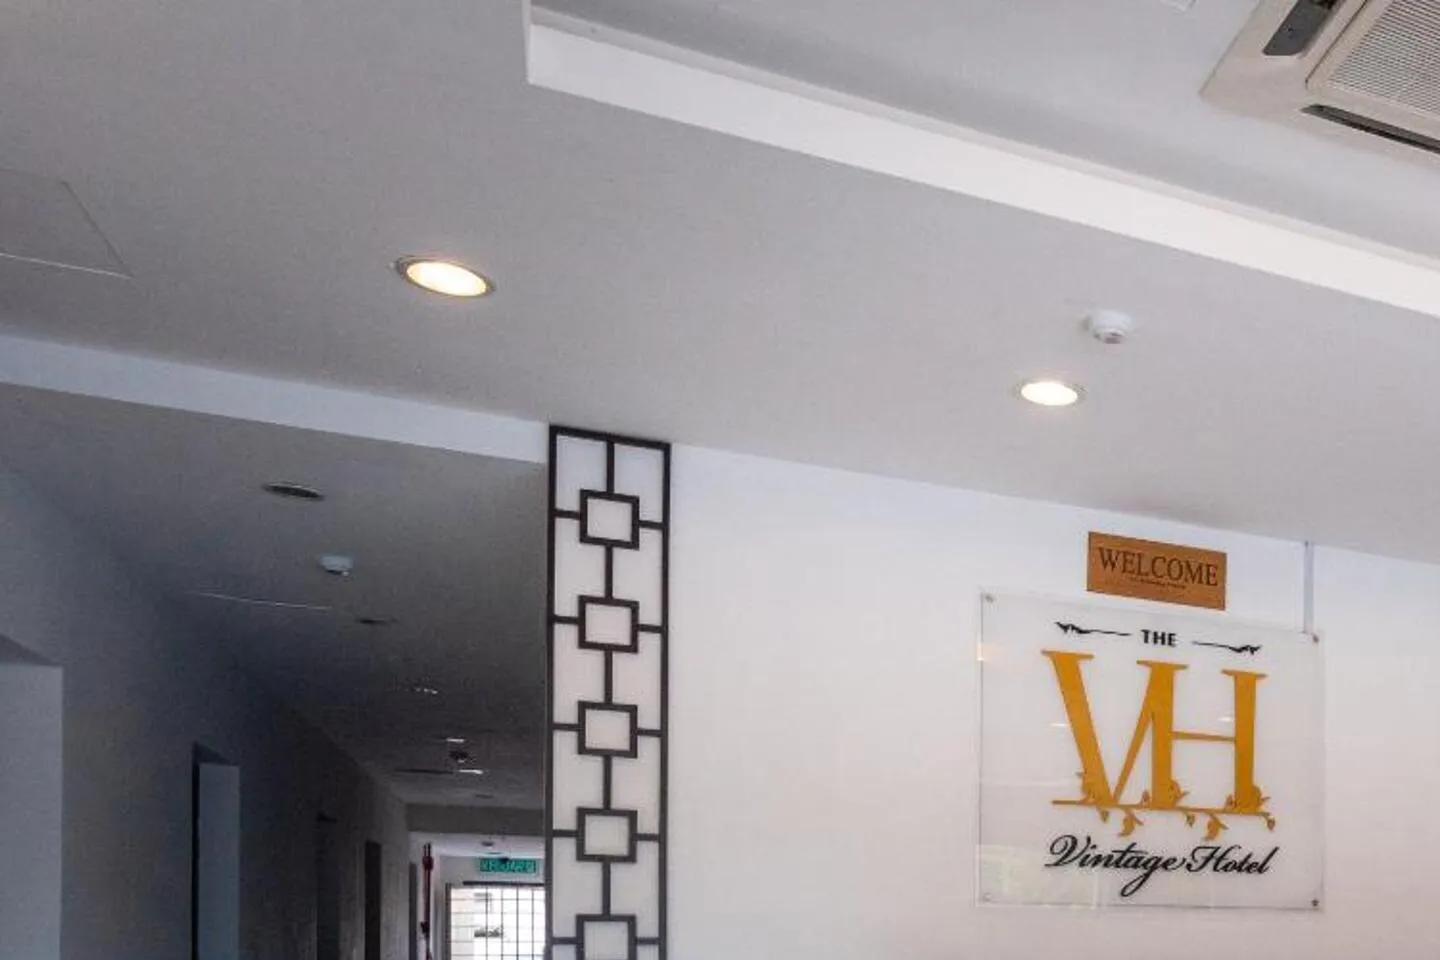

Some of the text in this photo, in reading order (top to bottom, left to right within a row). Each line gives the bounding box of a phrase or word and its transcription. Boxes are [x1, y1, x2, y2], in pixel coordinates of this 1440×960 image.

[1098, 547, 1218, 586] WELCOME
[1141, 629, 1176, 648] THE
[1041, 650, 1268, 813] VH
[1045, 834, 1280, 897] Vintage Hotel
